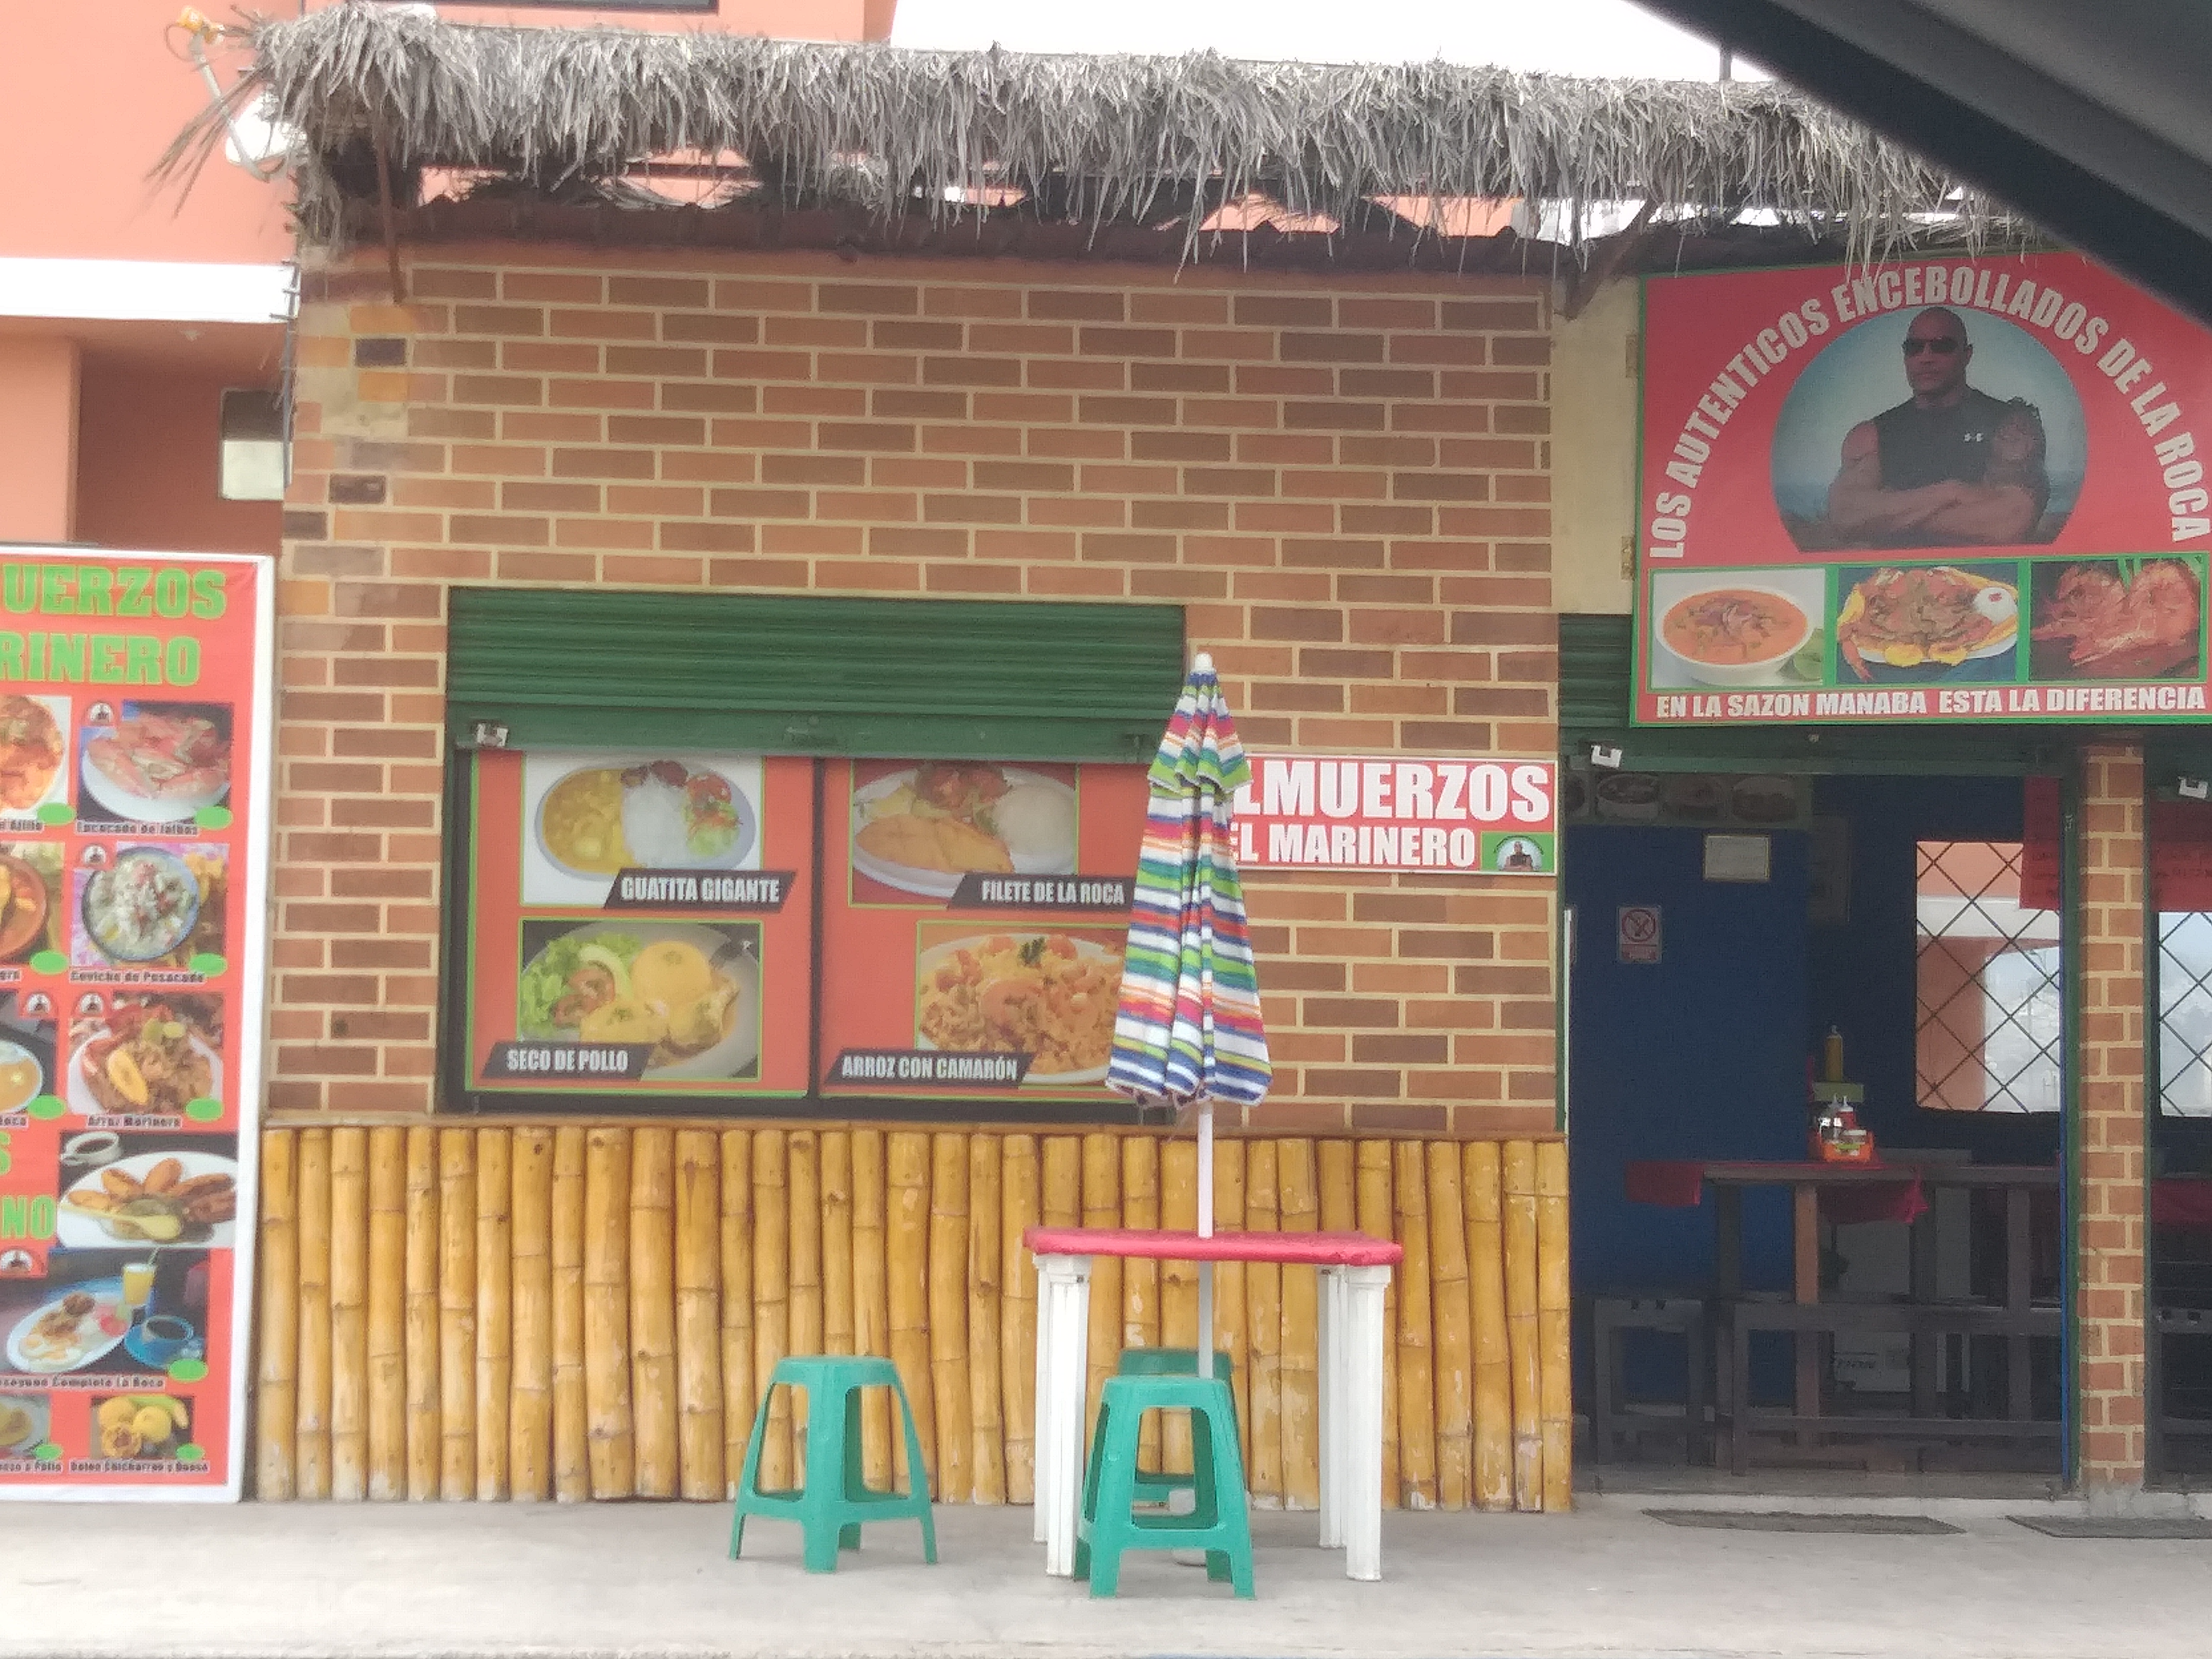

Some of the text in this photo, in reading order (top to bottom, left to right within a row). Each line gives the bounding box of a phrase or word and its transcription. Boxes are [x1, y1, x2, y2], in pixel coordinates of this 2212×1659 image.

[1649, 265, 2210, 558] LOS AUTENTICOS ENCEBOLLADOS DE LA ROCA
[3, 563, 227, 619] UERZOS
[1657, 686, 2206, 718] EN LA SAZON MANABA ESTA LA DIFERENCIA
[1233, 760, 1550, 822] LMUERZOS
[1269, 824, 1476, 867] MARINERO
[621, 877, 780, 903] GUATITA GIGANTE
[982, 880, 1125, 905] FILETE DE LA ROCA
[506, 1049, 628, 1072] SECO DE POLLO
[842, 1054, 1018, 1080] ARROZ CON CAMARÓN
